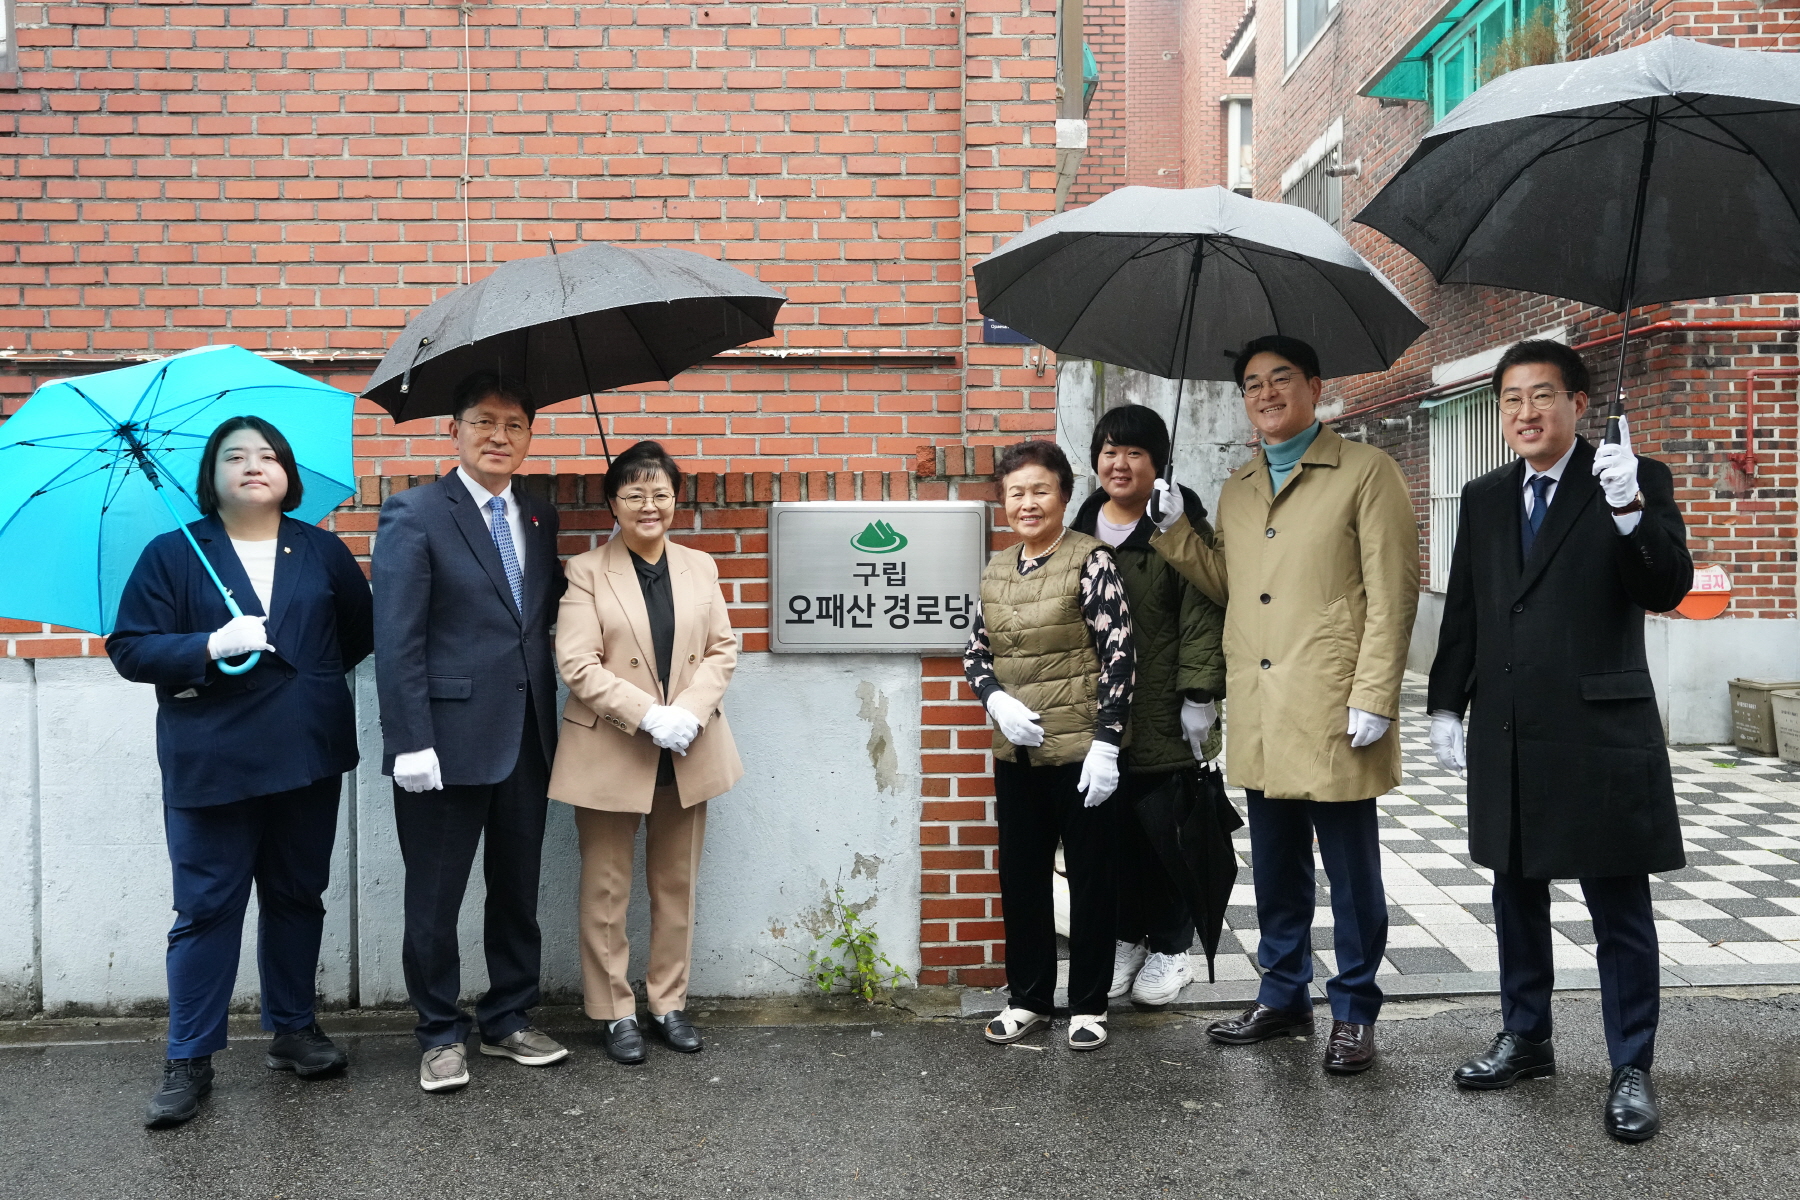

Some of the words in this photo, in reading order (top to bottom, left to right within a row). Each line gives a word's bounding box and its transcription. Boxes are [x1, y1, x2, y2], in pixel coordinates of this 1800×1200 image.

[853, 561, 906, 587] 구립
[785, 593, 876, 629] 오패산
[883, 593, 974, 630] 경로당
